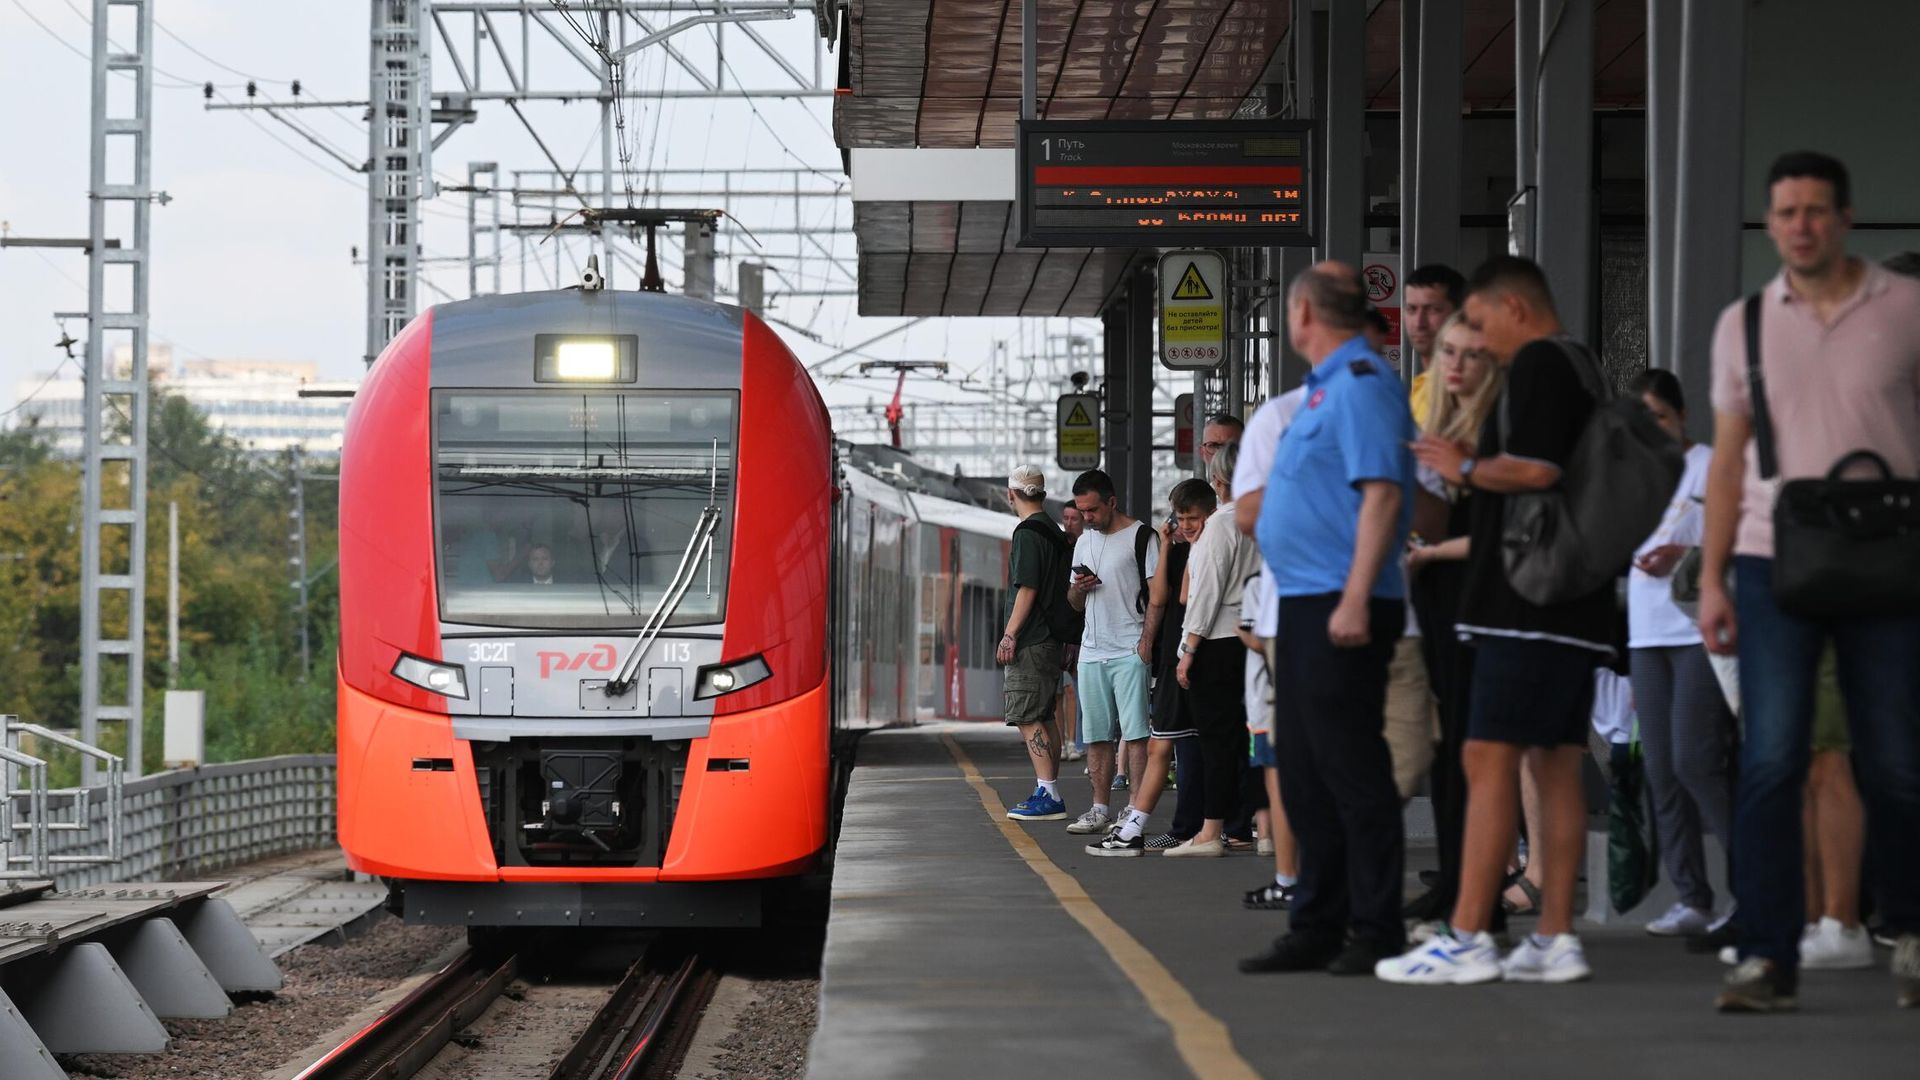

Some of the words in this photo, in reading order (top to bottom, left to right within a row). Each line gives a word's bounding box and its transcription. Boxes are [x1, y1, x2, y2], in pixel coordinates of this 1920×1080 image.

[1041, 139, 1050, 160] 1
[1058, 139, 1085, 151] Путь
[1060, 153, 1082, 161] Track
[1179, 310, 1218, 318] оставляйте
[1180, 324, 1220, 332] присмотра!
[468, 643, 515, 662] ЭС2Г
[664, 643, 690, 662] 113
